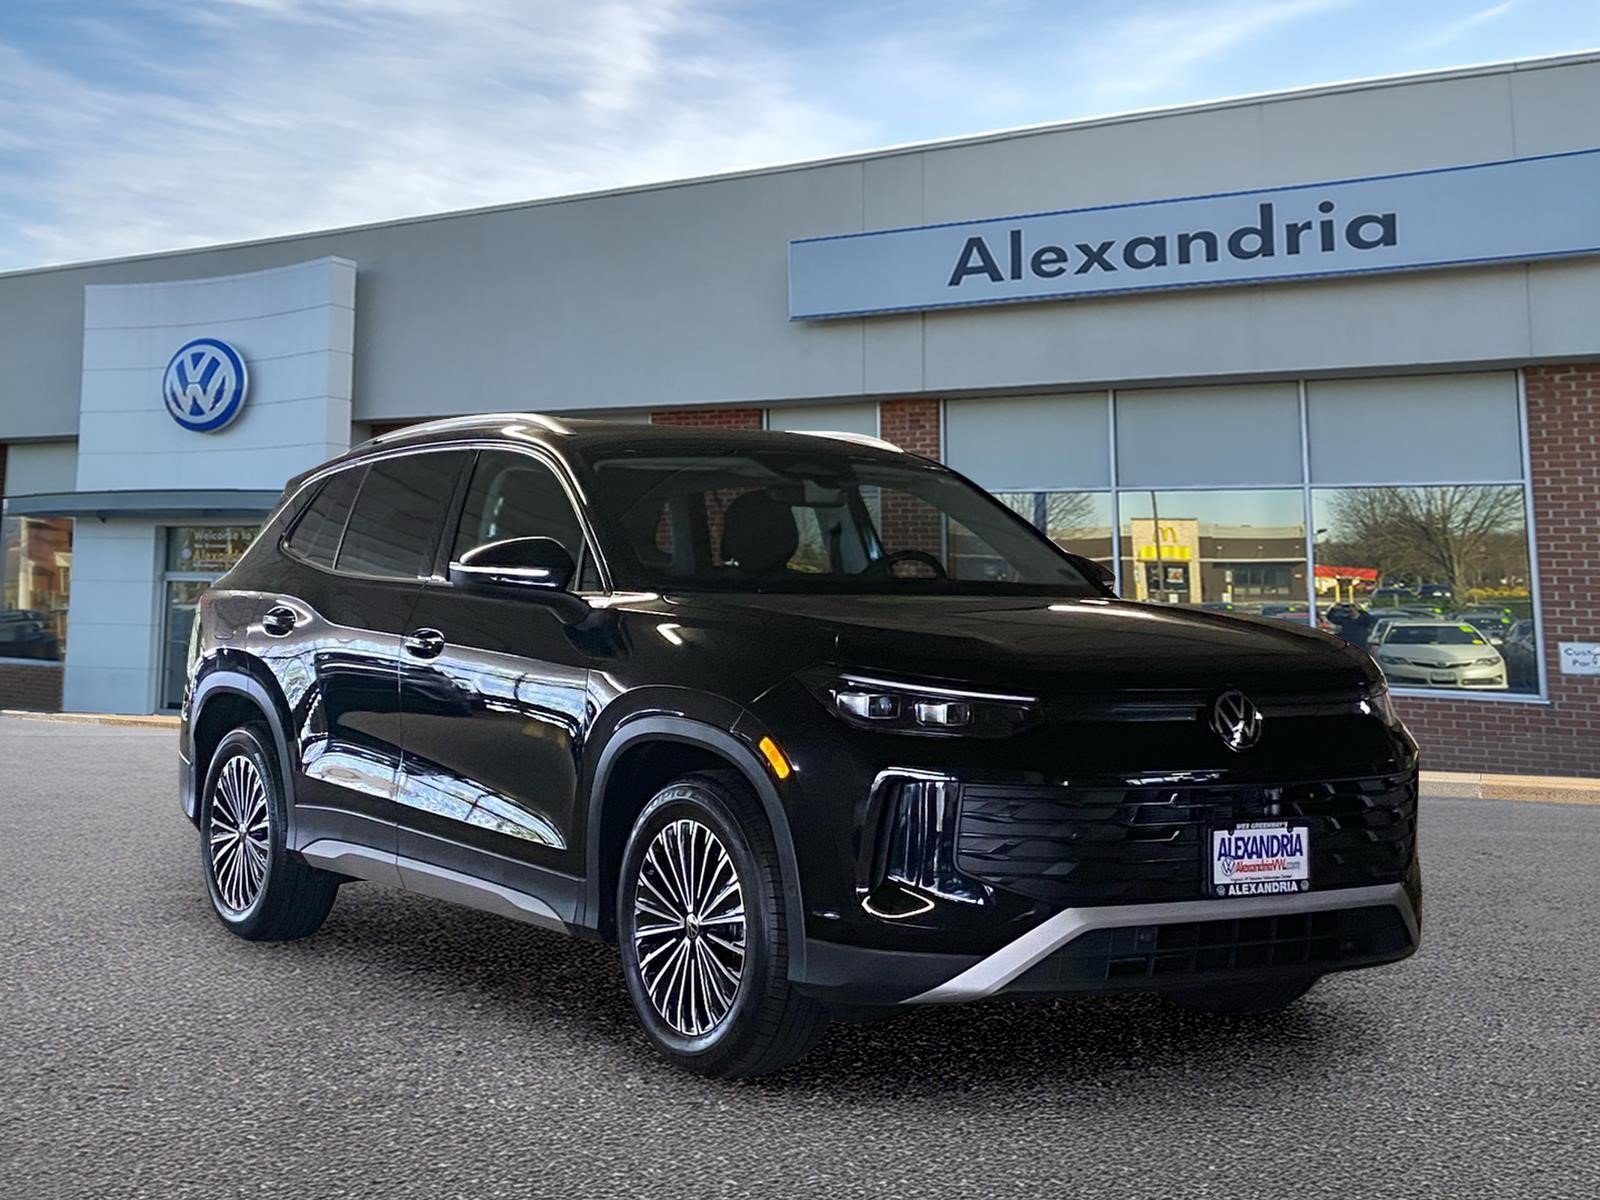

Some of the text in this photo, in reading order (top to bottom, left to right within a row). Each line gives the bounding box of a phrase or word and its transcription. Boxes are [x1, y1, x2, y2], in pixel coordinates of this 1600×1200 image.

[948, 201, 1397, 286] Alexandria
[165, 339, 244, 429] VW
[1217, 833, 1303, 861] ALEXANDRIA
[1228, 881, 1298, 896] ALEXANDRIA
